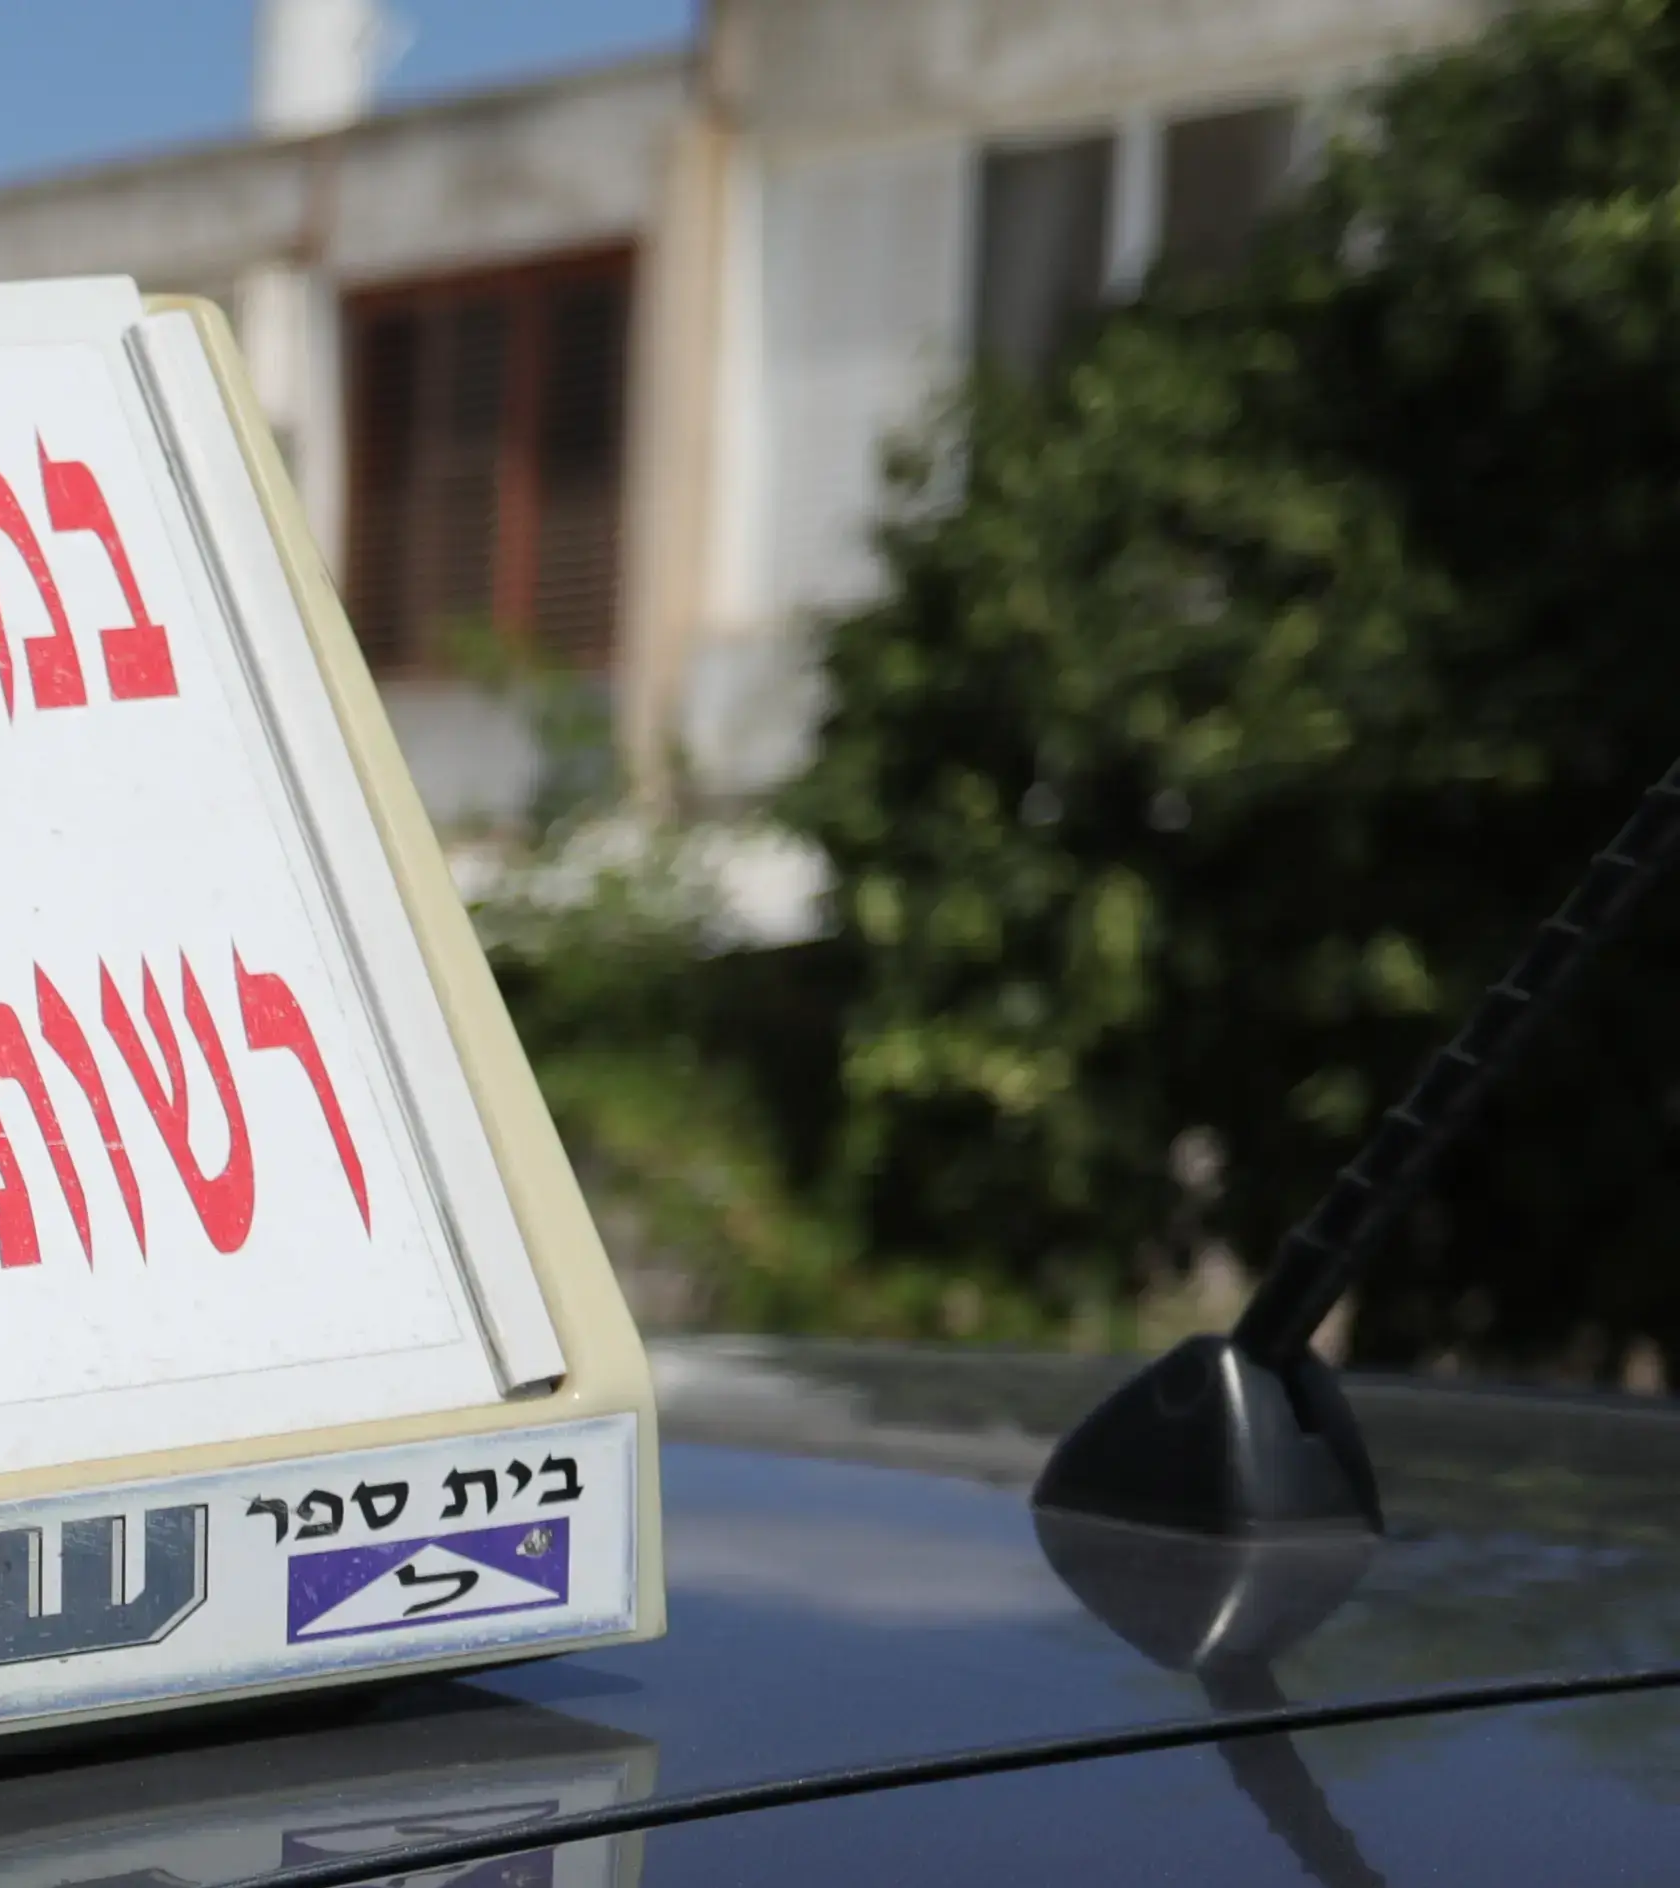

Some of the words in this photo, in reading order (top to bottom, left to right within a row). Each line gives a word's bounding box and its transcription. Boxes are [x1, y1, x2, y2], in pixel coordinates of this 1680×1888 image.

[244, 1480, 410, 1545] ספר
[440, 1451, 586, 1520] בית
[394, 1563, 480, 1616] ל
